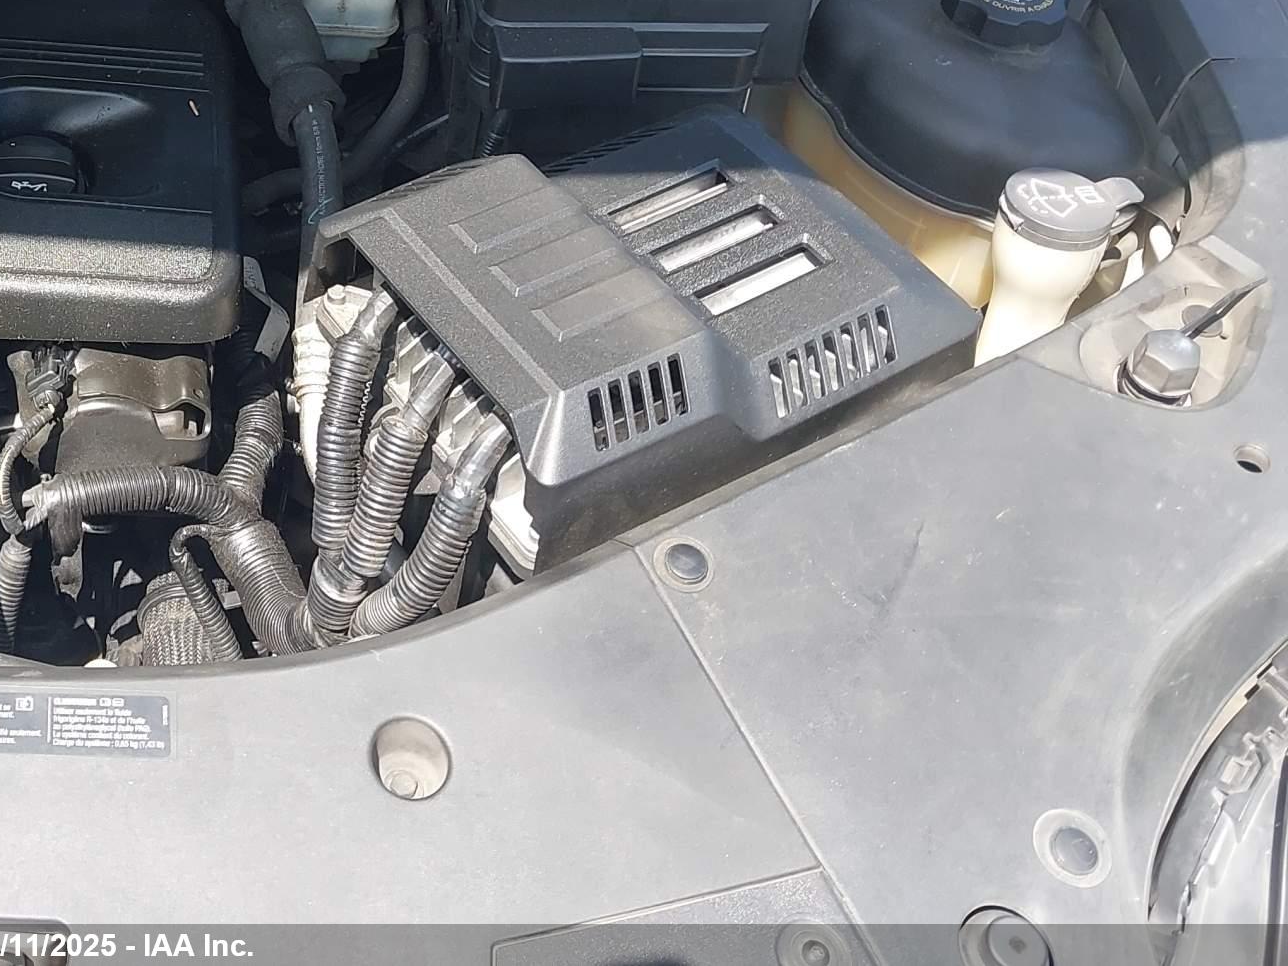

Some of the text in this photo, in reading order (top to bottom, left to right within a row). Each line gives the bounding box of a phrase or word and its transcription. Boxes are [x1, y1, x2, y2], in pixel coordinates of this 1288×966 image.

[992, 0, 1026, 14] OUVRIR
[316, 155, 325, 173] HOSE
[317, 174, 326, 203] SUCTION
